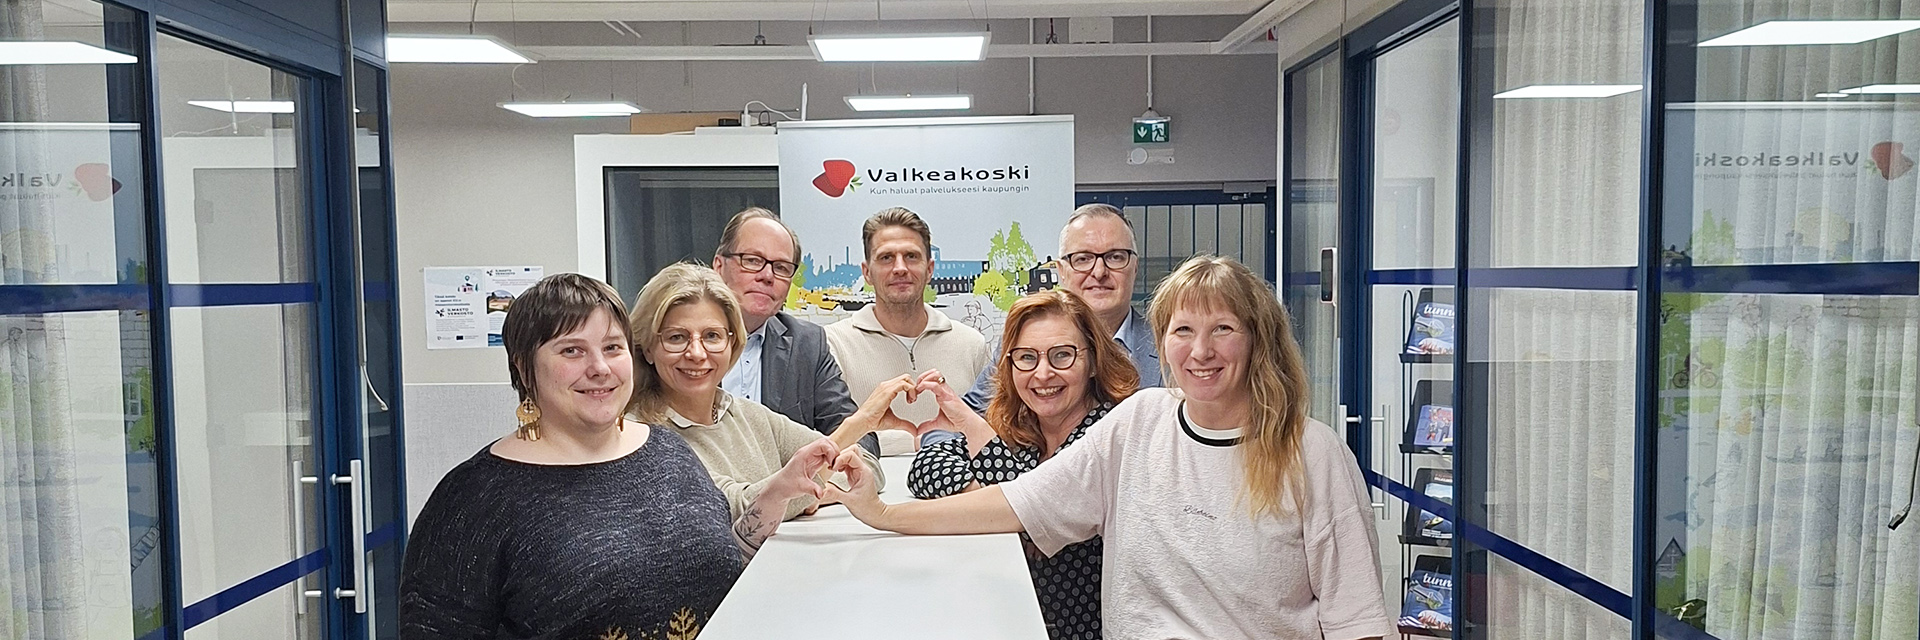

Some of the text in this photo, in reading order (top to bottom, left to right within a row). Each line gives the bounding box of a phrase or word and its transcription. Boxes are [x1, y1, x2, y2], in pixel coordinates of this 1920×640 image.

[867, 165, 1030, 183] Valkeakoski
[869, 185, 1030, 196] Kun haluat palvelukseesi kaupungin
